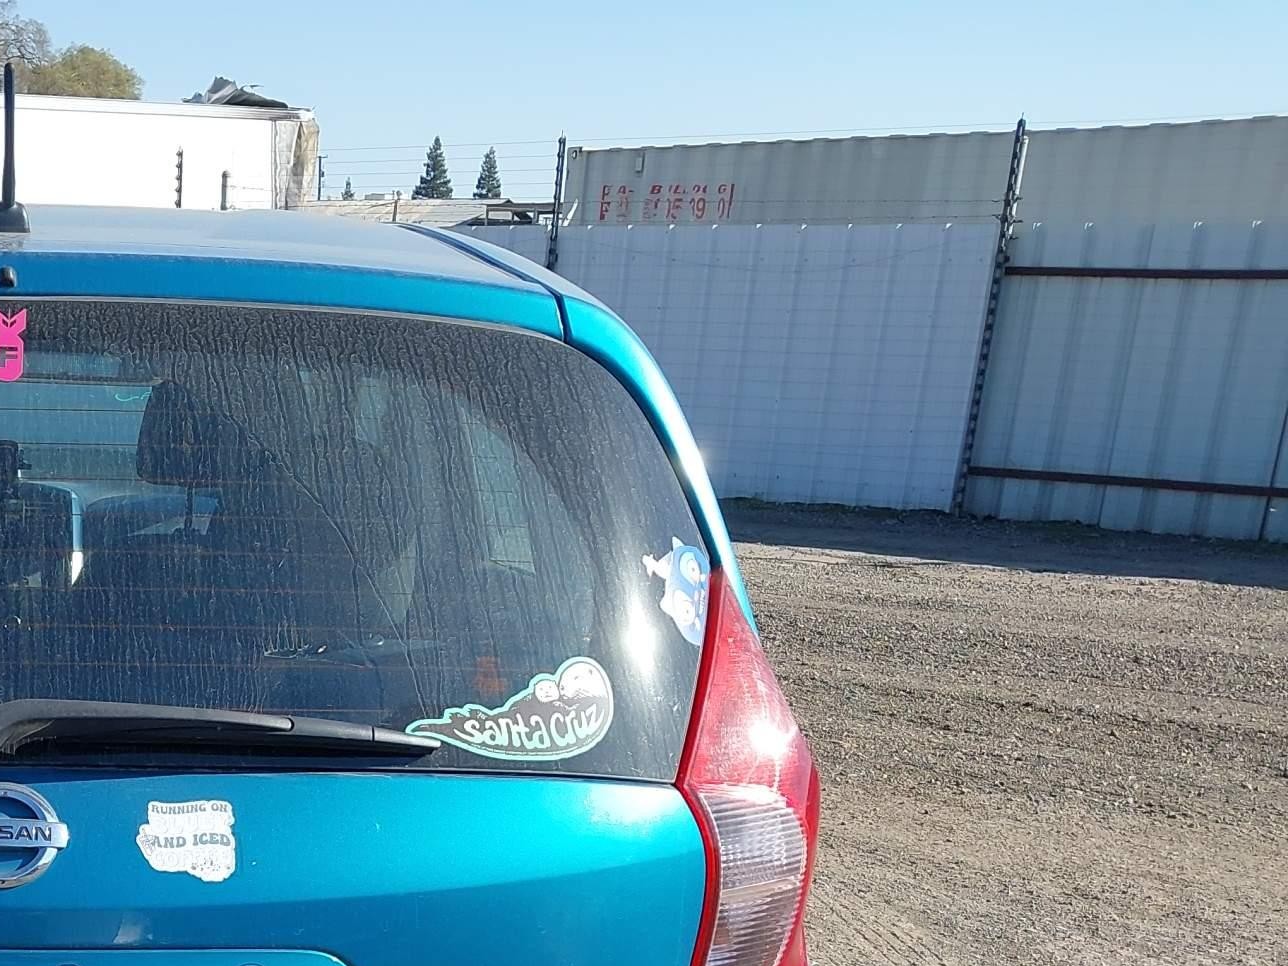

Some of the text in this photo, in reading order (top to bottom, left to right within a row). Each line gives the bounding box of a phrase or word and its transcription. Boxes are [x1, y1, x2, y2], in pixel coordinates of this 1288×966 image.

[151, 803, 228, 815] RUNNING ON
[151, 832, 231, 848] AND ICED
